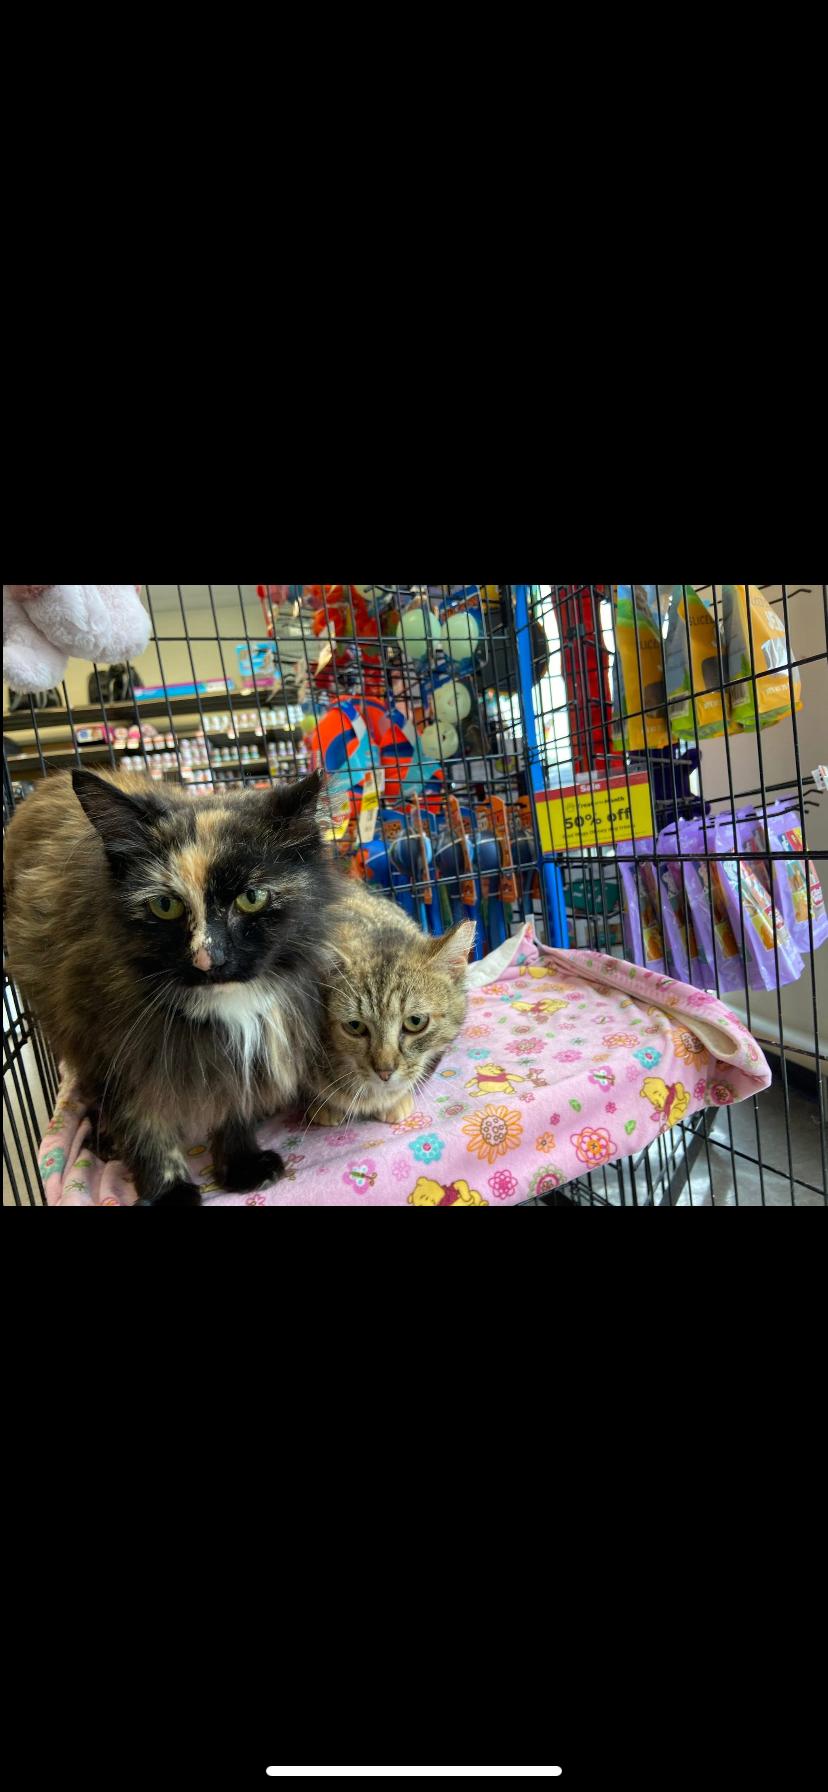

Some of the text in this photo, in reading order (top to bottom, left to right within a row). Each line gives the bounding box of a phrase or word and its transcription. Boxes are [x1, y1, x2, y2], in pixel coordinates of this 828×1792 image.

[581, 783, 600, 793] Sale
[565, 807, 631, 829] 50% off
